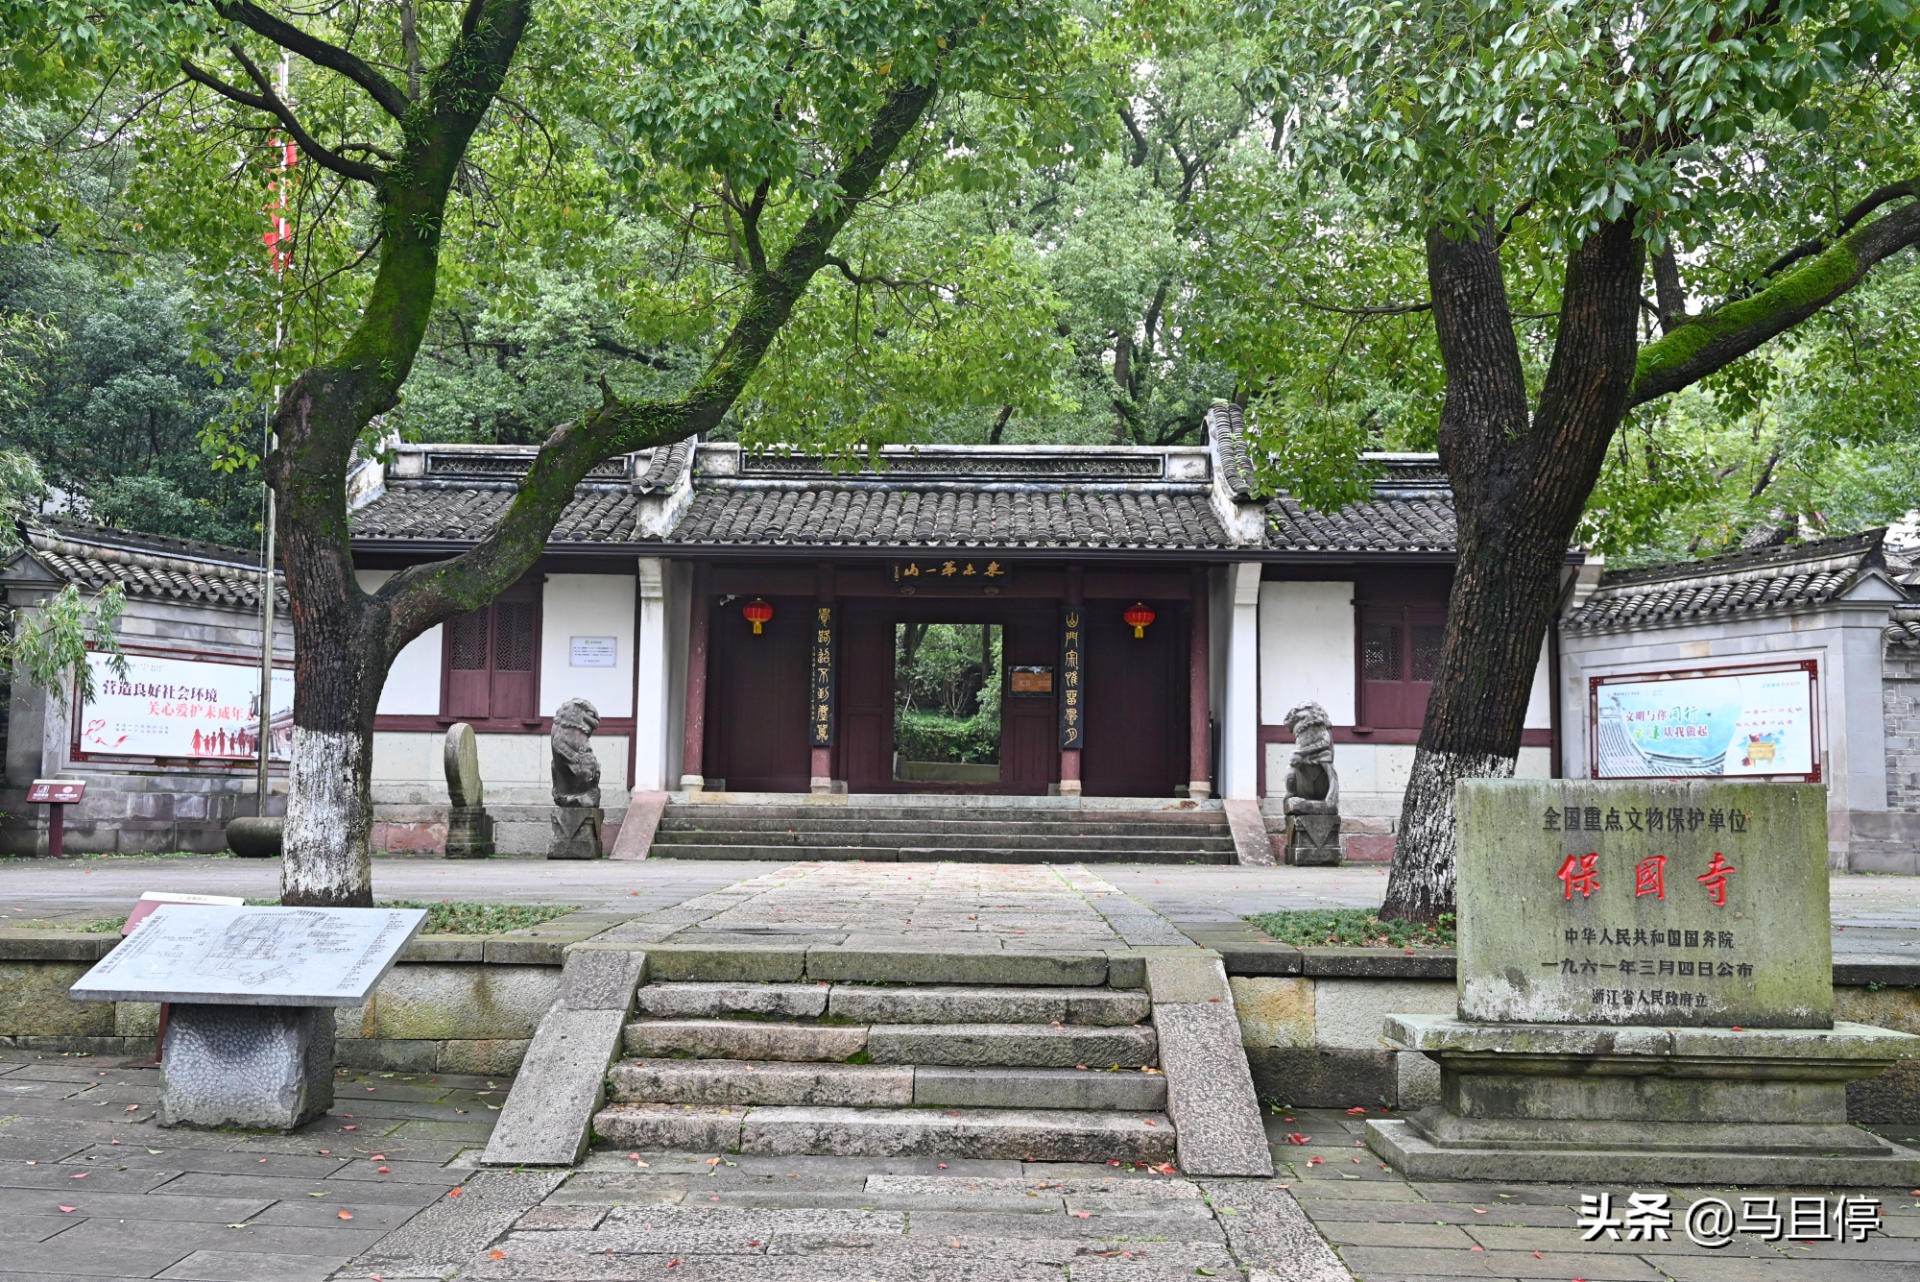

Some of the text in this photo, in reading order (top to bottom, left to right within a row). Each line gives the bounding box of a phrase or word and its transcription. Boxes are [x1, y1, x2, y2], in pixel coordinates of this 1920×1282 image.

[102, 680, 219, 703] 营造良好社会环境
[1542, 806, 1748, 833] 全国重点文物保护单位
[1564, 928, 1735, 949] 中华人民共和国国务院
[1541, 958, 1754, 978] 一九六一年三月四日公布
[1592, 989, 1708, 1008] 浙江省人民政府立
